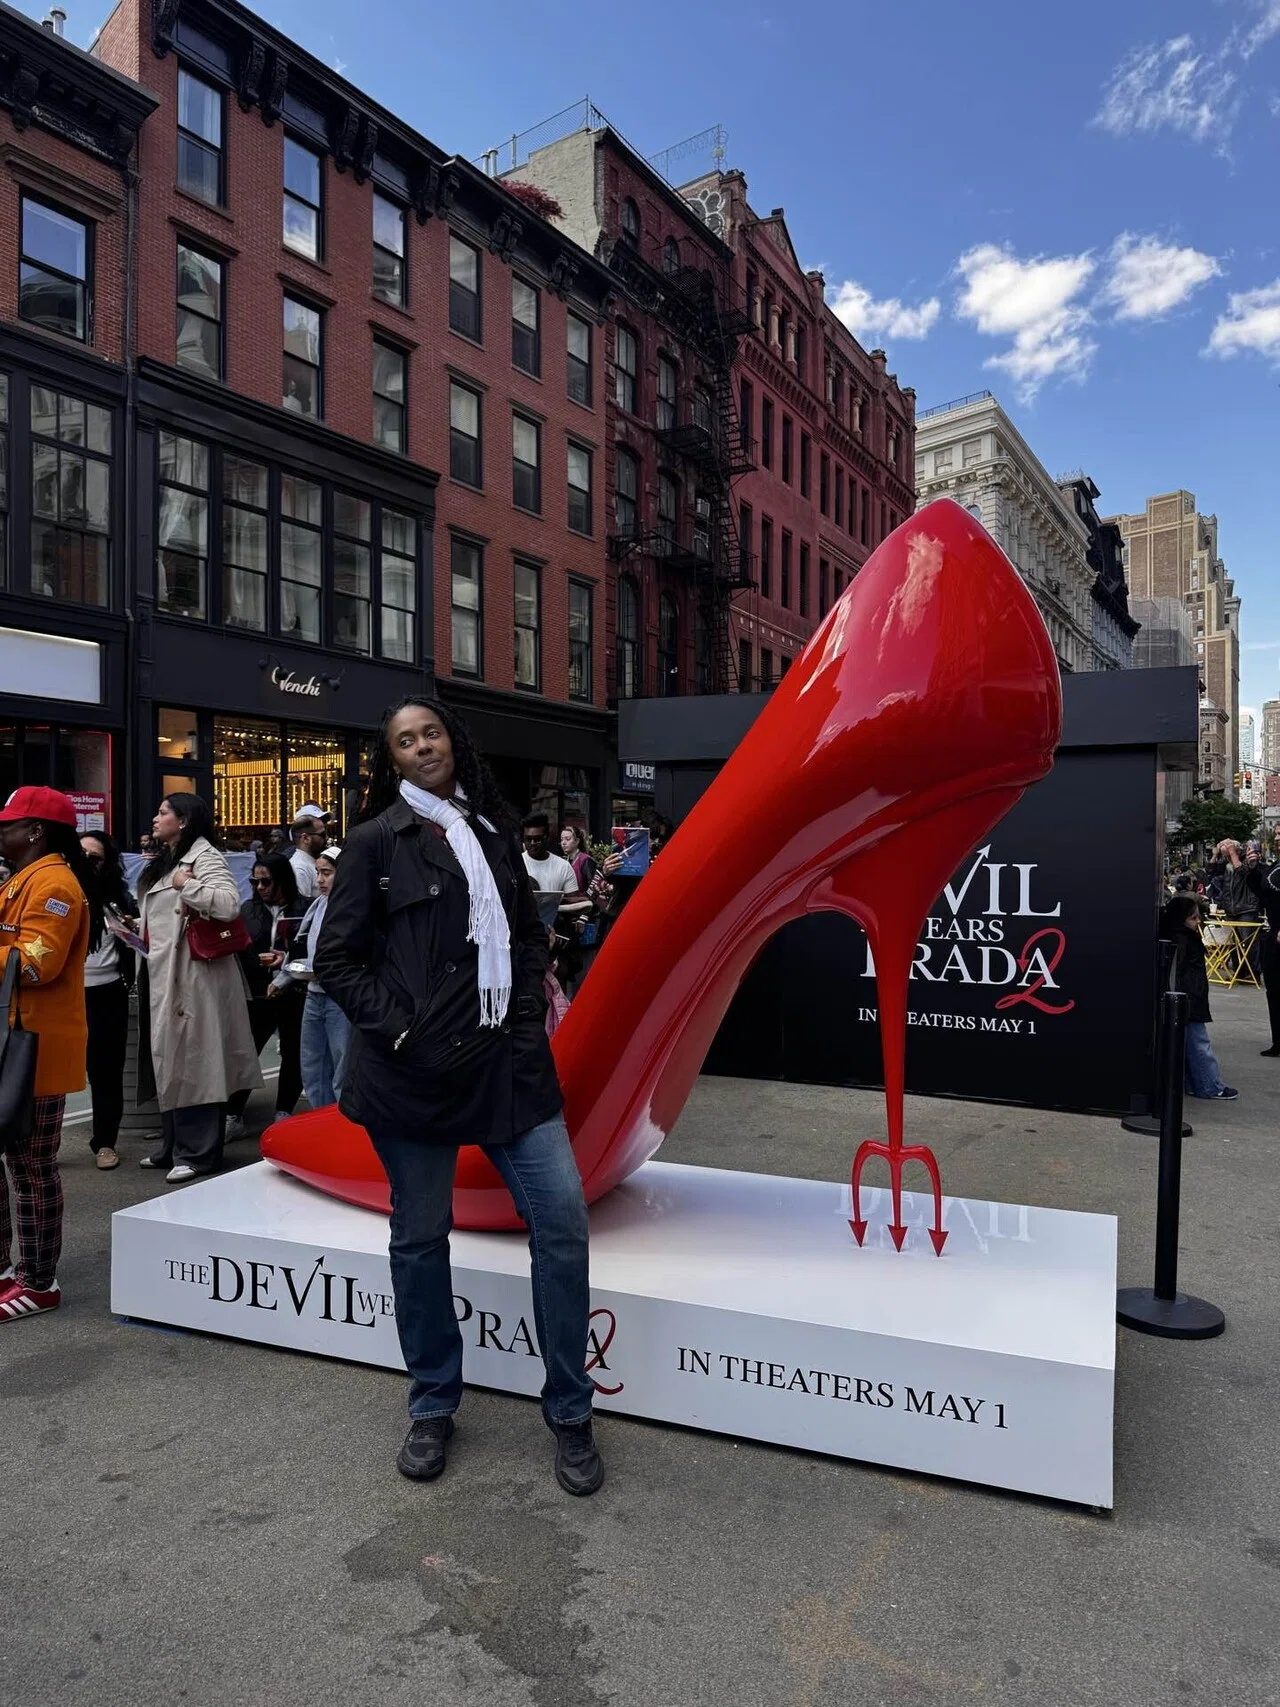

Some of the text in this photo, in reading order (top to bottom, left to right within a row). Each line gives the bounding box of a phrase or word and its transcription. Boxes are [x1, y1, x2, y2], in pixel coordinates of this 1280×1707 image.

[271, 666, 321, 697] Venchi
[72, 803, 100, 811] nternet
[82, 795, 105, 804] Home
[943, 843, 1061, 917] VIL
[925, 917, 1005, 942] EARS
[995, 927, 1076, 1015] 2
[858, 1007, 1037, 1035] IN EATERS MAY 1
[165, 1259, 210, 1286] THE
[208, 1254, 376, 1328] DEVIL
[452, 1294, 612, 1371] PRAA
[677, 1347, 1009, 1430] IN THEATERS MAY 1
